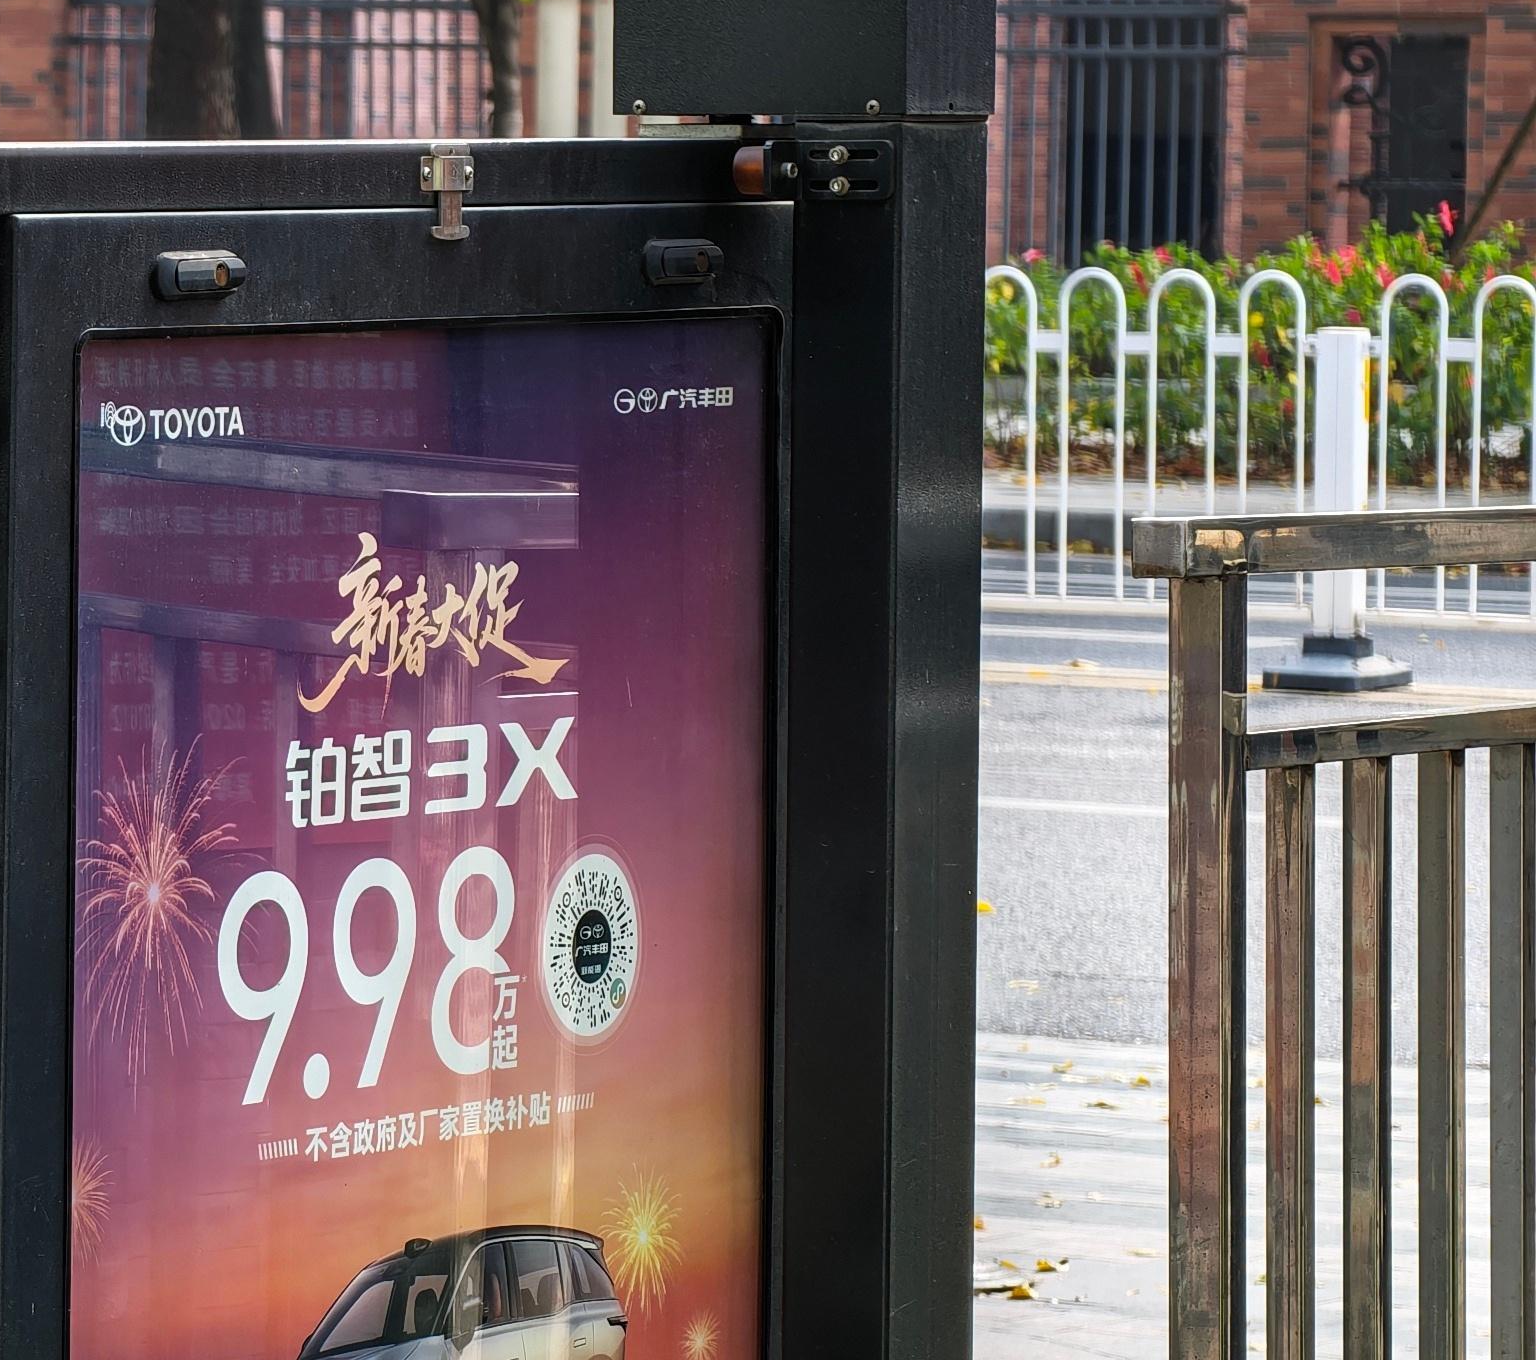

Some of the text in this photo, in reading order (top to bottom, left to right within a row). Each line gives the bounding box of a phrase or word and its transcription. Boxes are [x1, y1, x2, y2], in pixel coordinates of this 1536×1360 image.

[150, 406, 245, 440] TOYOTA
[659, 386, 734, 410] 广汽丰田
[297, 531, 571, 720] 新春大促
[217, 846, 516, 1106] 9.98
[304, 1091, 552, 1163] 不含政府及厂家置换补贴
